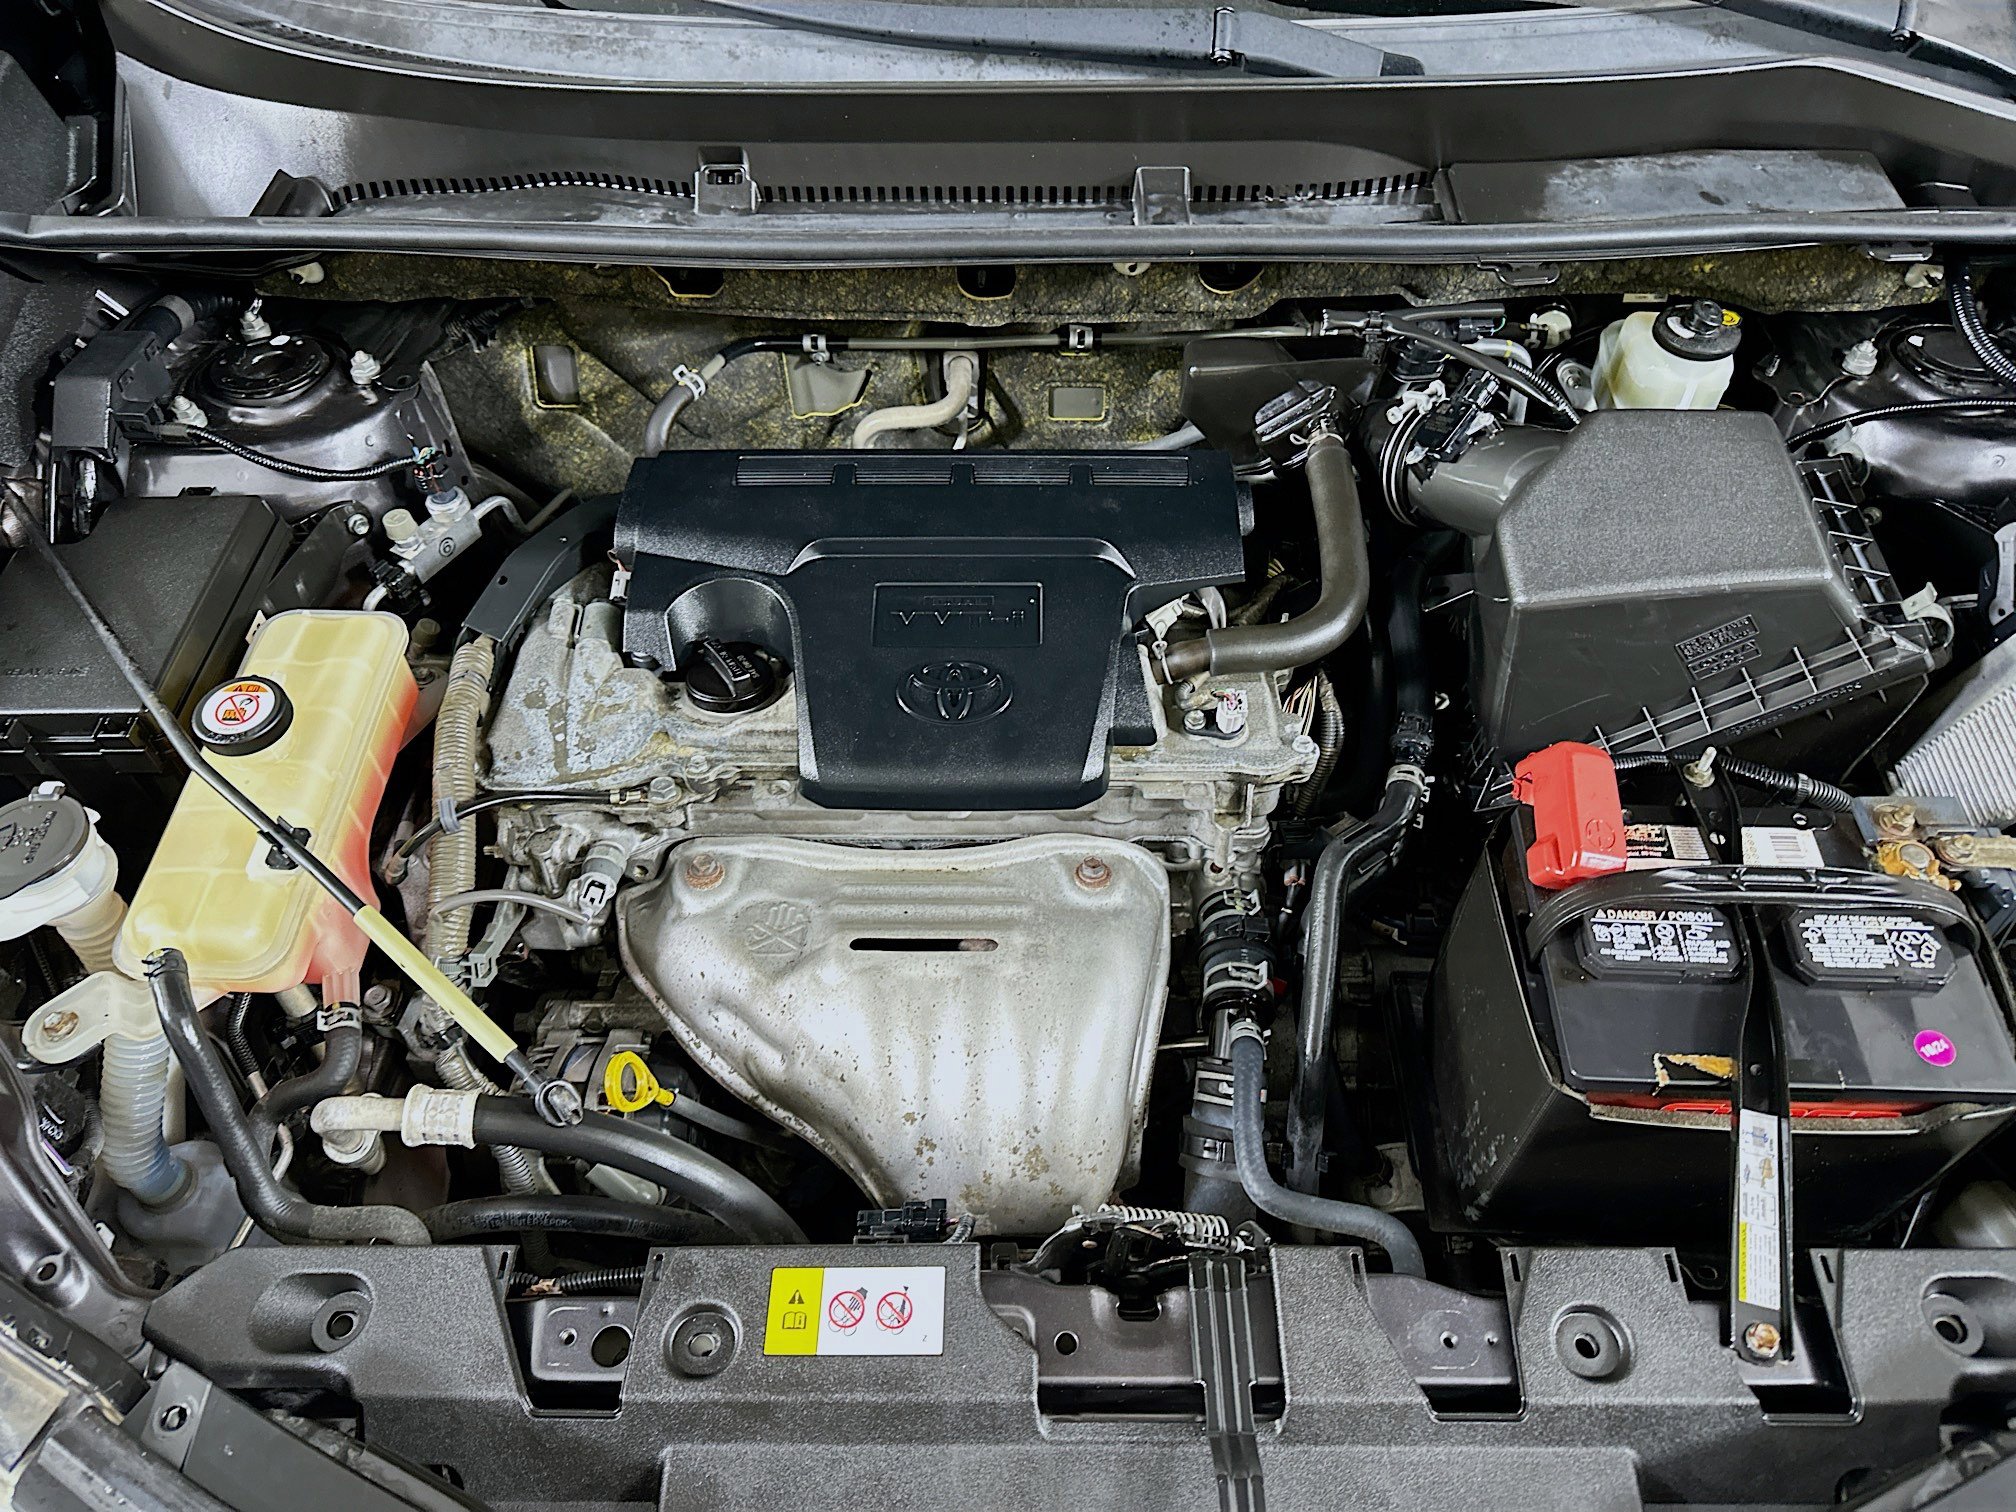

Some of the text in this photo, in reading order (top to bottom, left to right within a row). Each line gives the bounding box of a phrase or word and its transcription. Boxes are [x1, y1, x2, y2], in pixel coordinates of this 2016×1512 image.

[443, 541, 451, 553] 6
[1606, 909, 1657, 921] DANGER
[1667, 910, 1714, 922] POISON
